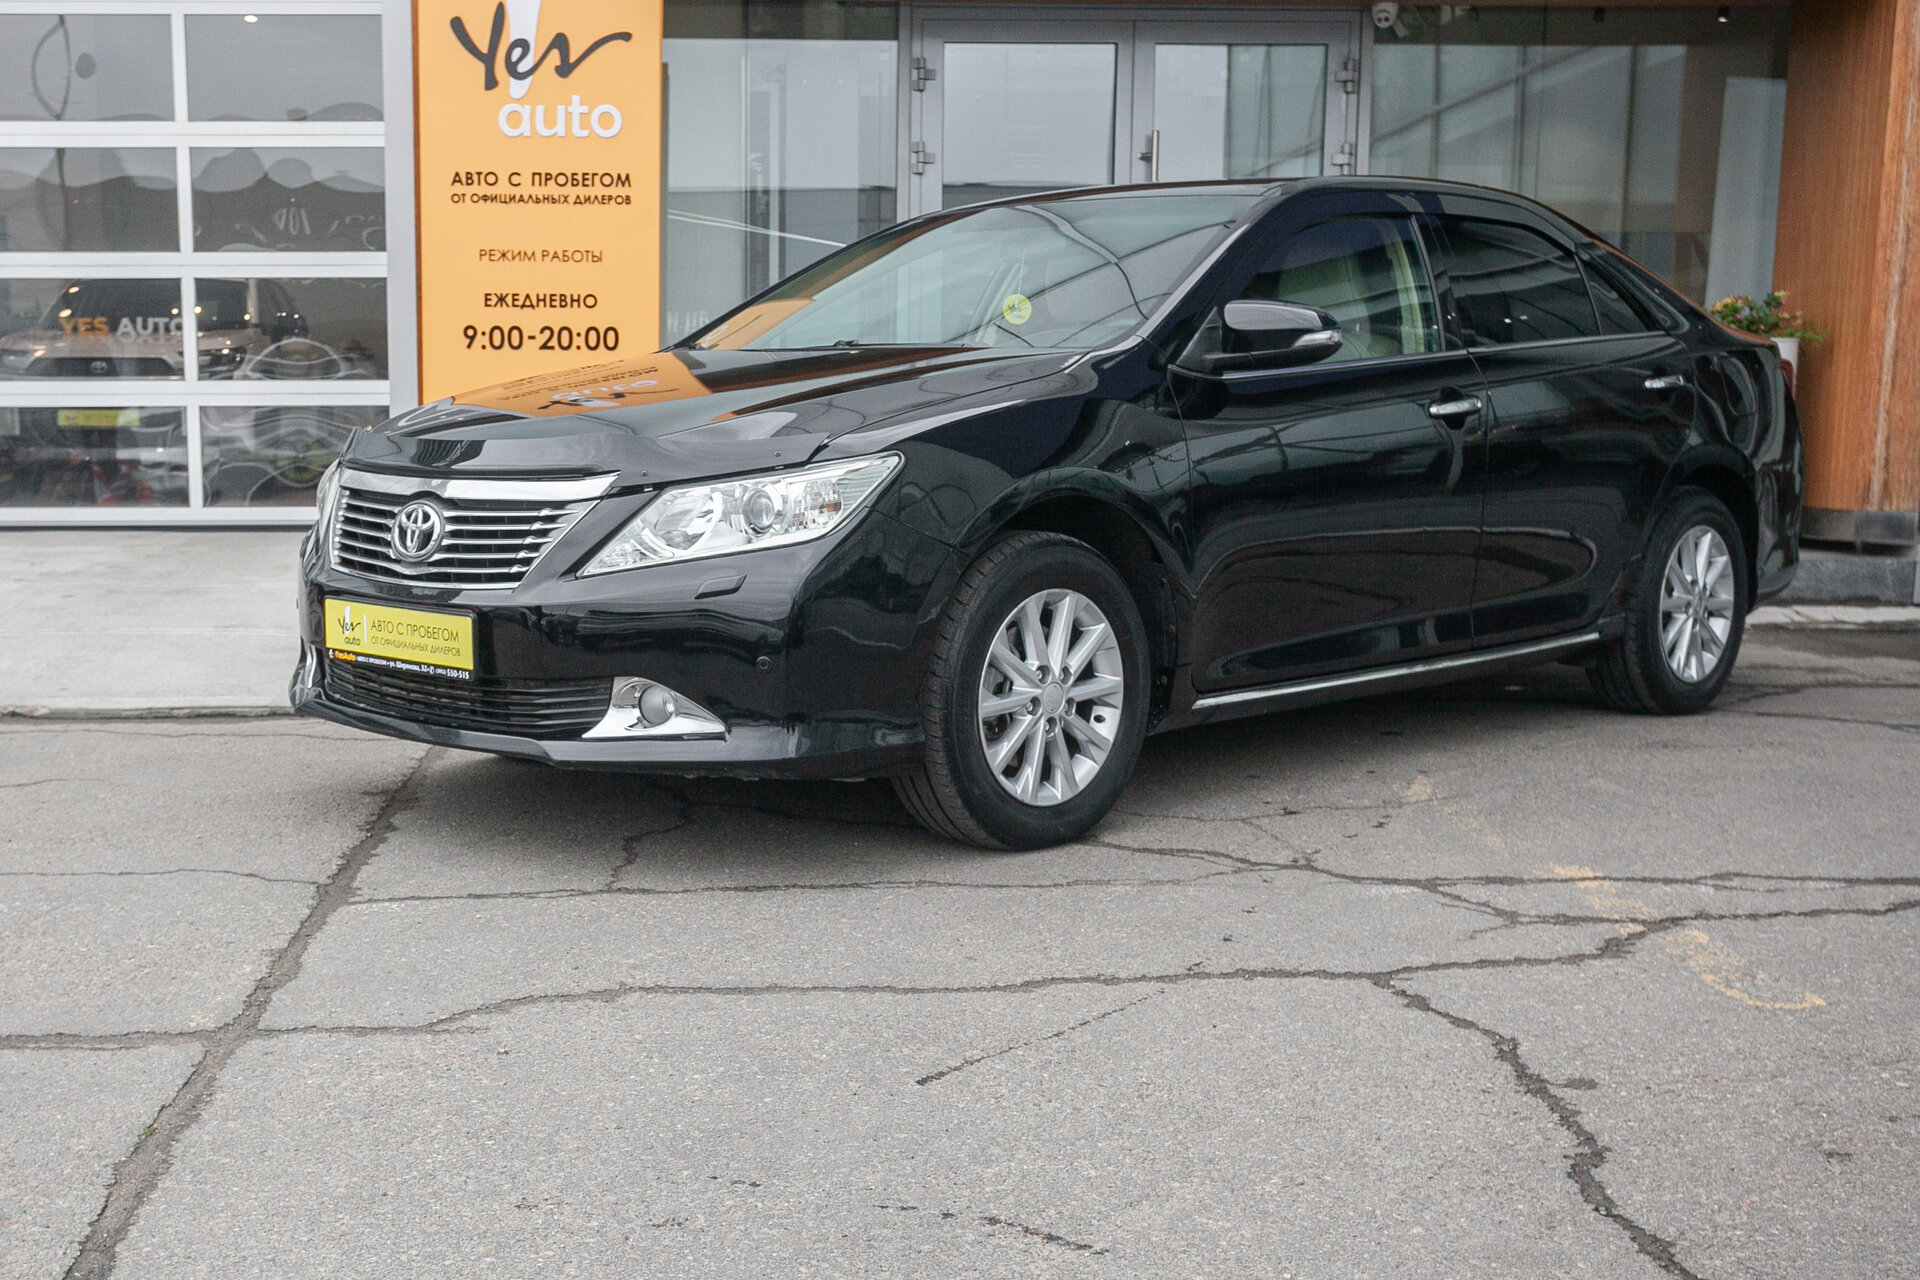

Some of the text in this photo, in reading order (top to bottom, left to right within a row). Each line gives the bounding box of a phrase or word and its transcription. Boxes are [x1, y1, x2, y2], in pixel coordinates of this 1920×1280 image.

[450, 2, 632, 91] Yes
[498, 94, 622, 138] auto
[451, 171, 632, 188] АВТО С ПРОБЕГОМ
[450, 193, 631, 206] ОТ ОФИЦИАЛЬНЫХ ДИЛЕРОВ
[479, 249, 603, 263] РЕЖИМ РАБОТЫ
[484, 293, 598, 309] ЕЖЕДНЕВНО
[59, 317, 110, 336] YES
[463, 325, 619, 351] 9:00-20:00
[337, 616, 361, 634] Yes
[371, 620, 459, 643] АВТО С ПРОБЕГОМ
[345, 636, 361, 646] auto
[371, 636, 461, 657] ОТ ОФИЦИАЛЬНЫХ ДИЛЕРОВ
[446, 669, 470, 680] 550-515
